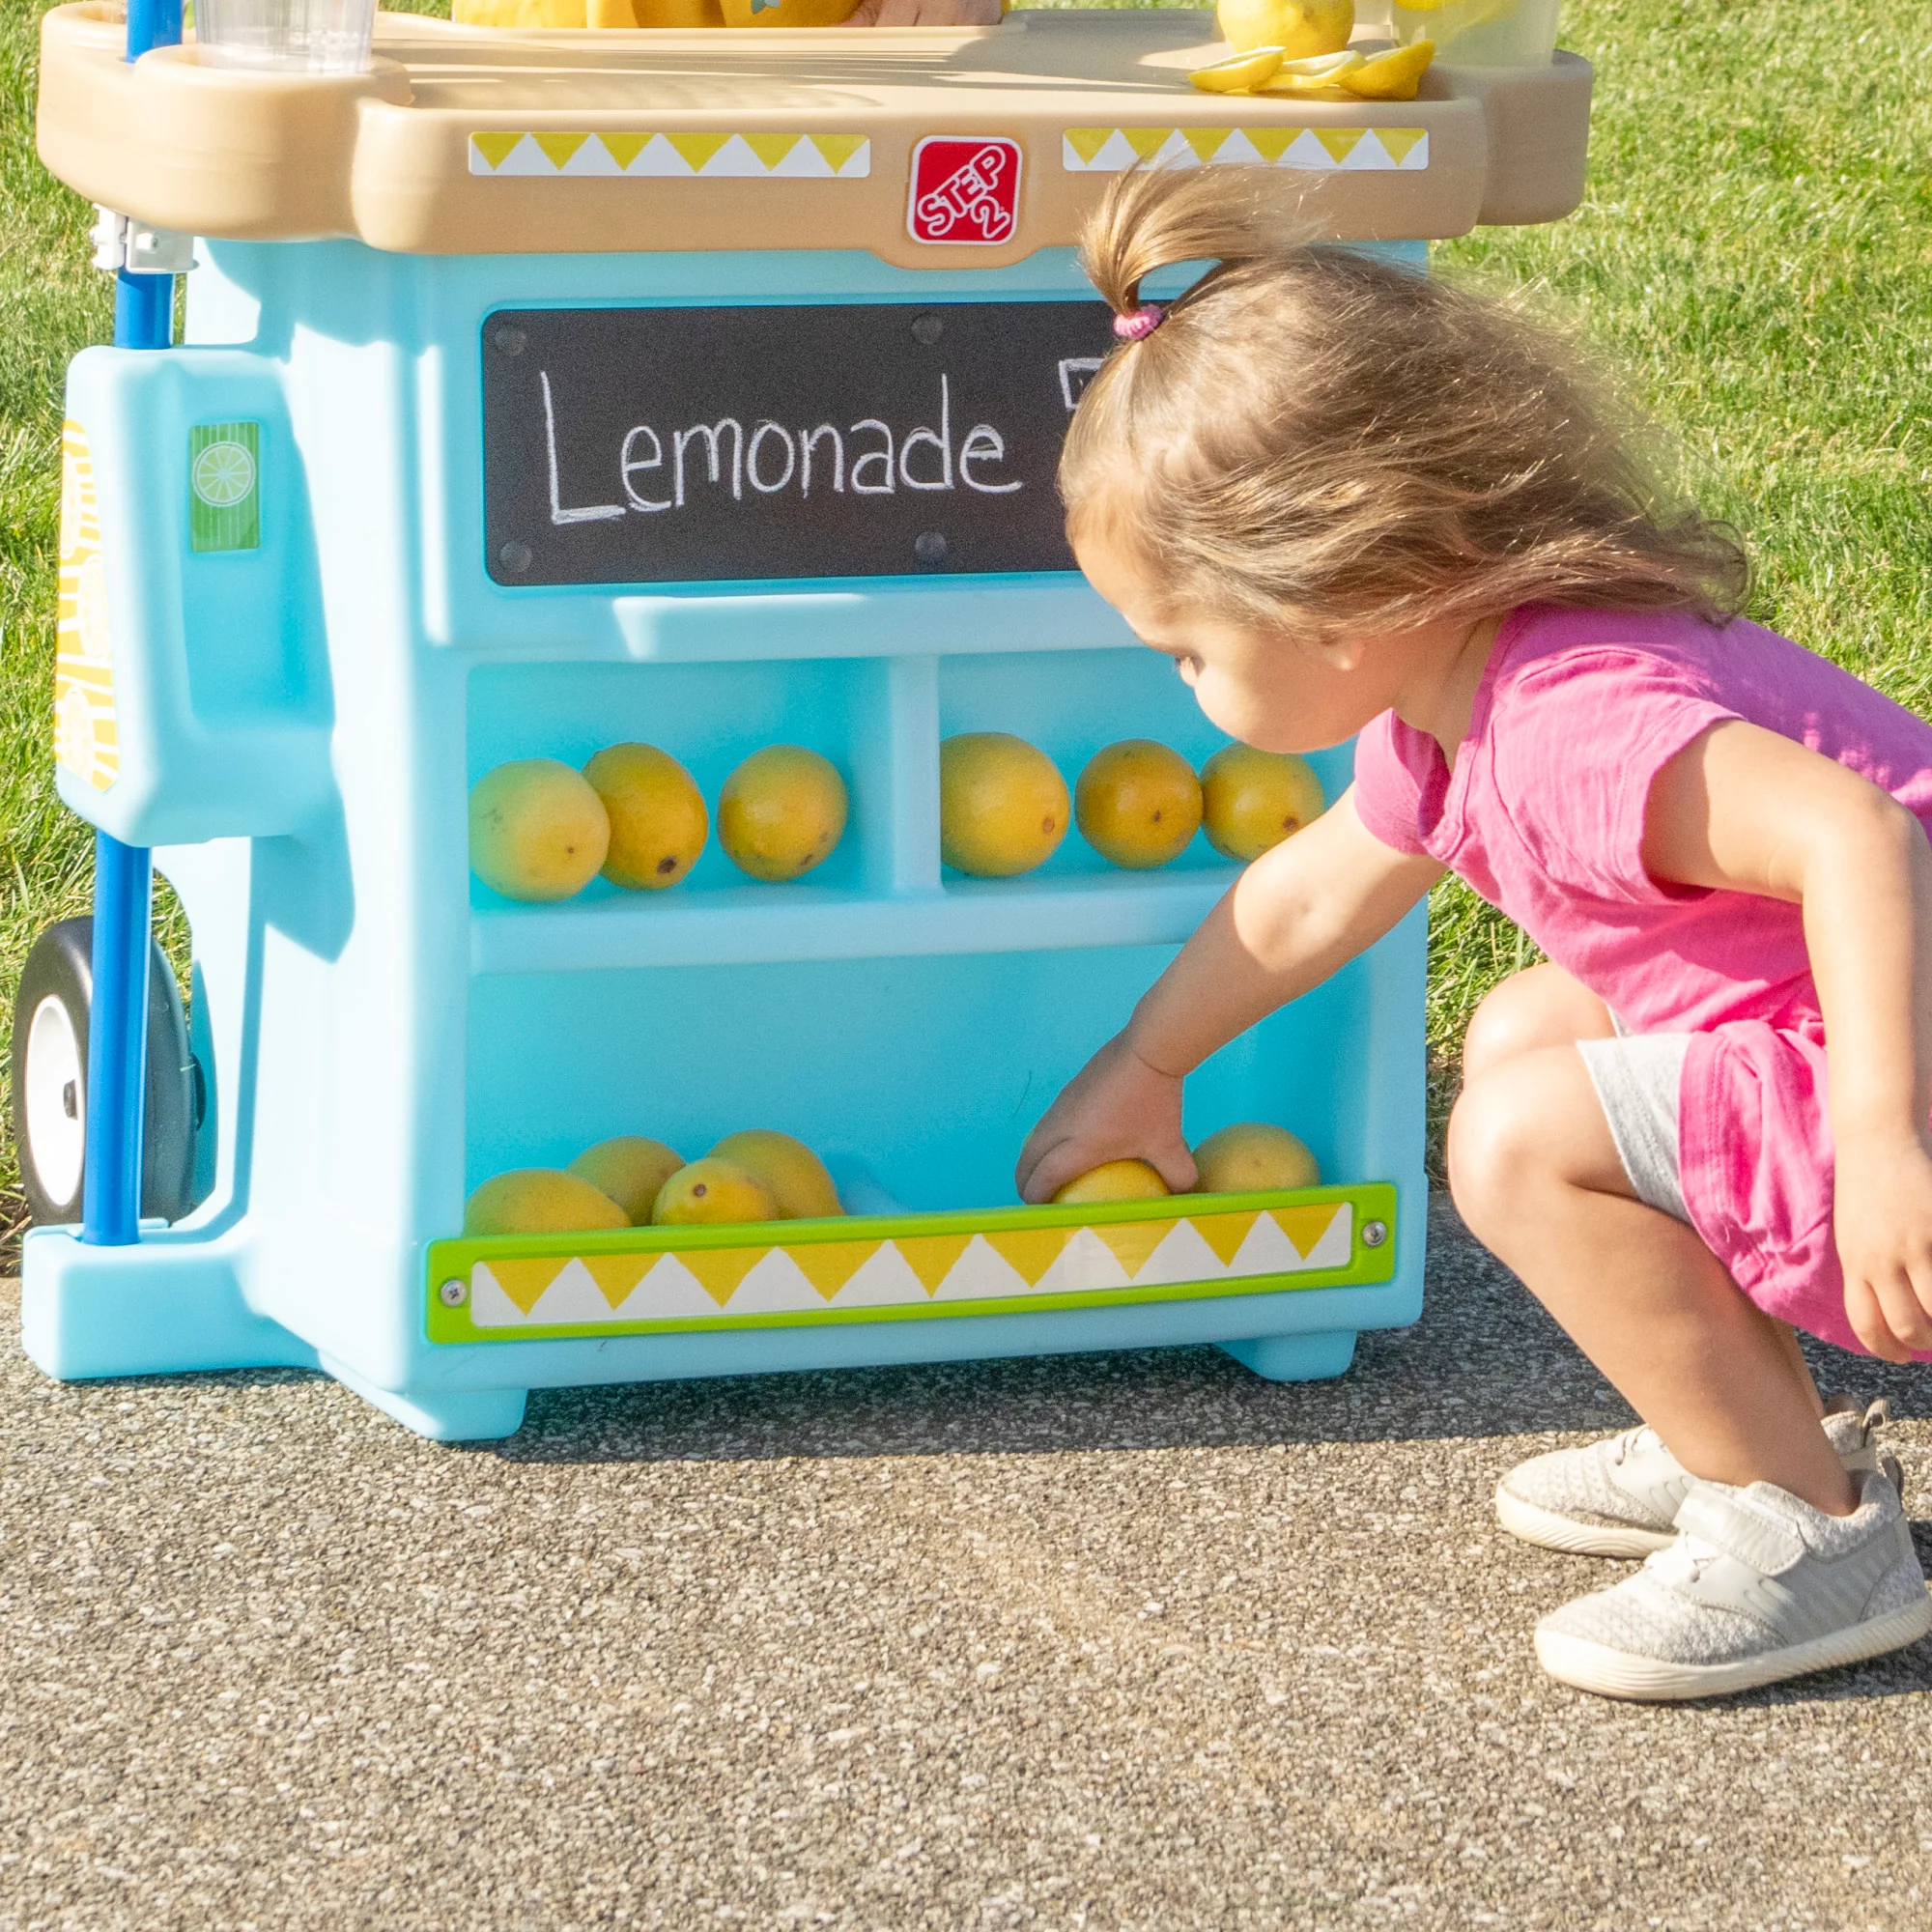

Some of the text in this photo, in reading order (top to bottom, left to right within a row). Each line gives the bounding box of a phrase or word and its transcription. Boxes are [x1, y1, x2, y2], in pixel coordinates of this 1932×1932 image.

[918, 145, 1006, 236] STEP
[970, 195, 1011, 239] 2
[540, 370, 1023, 525] Lemonade
